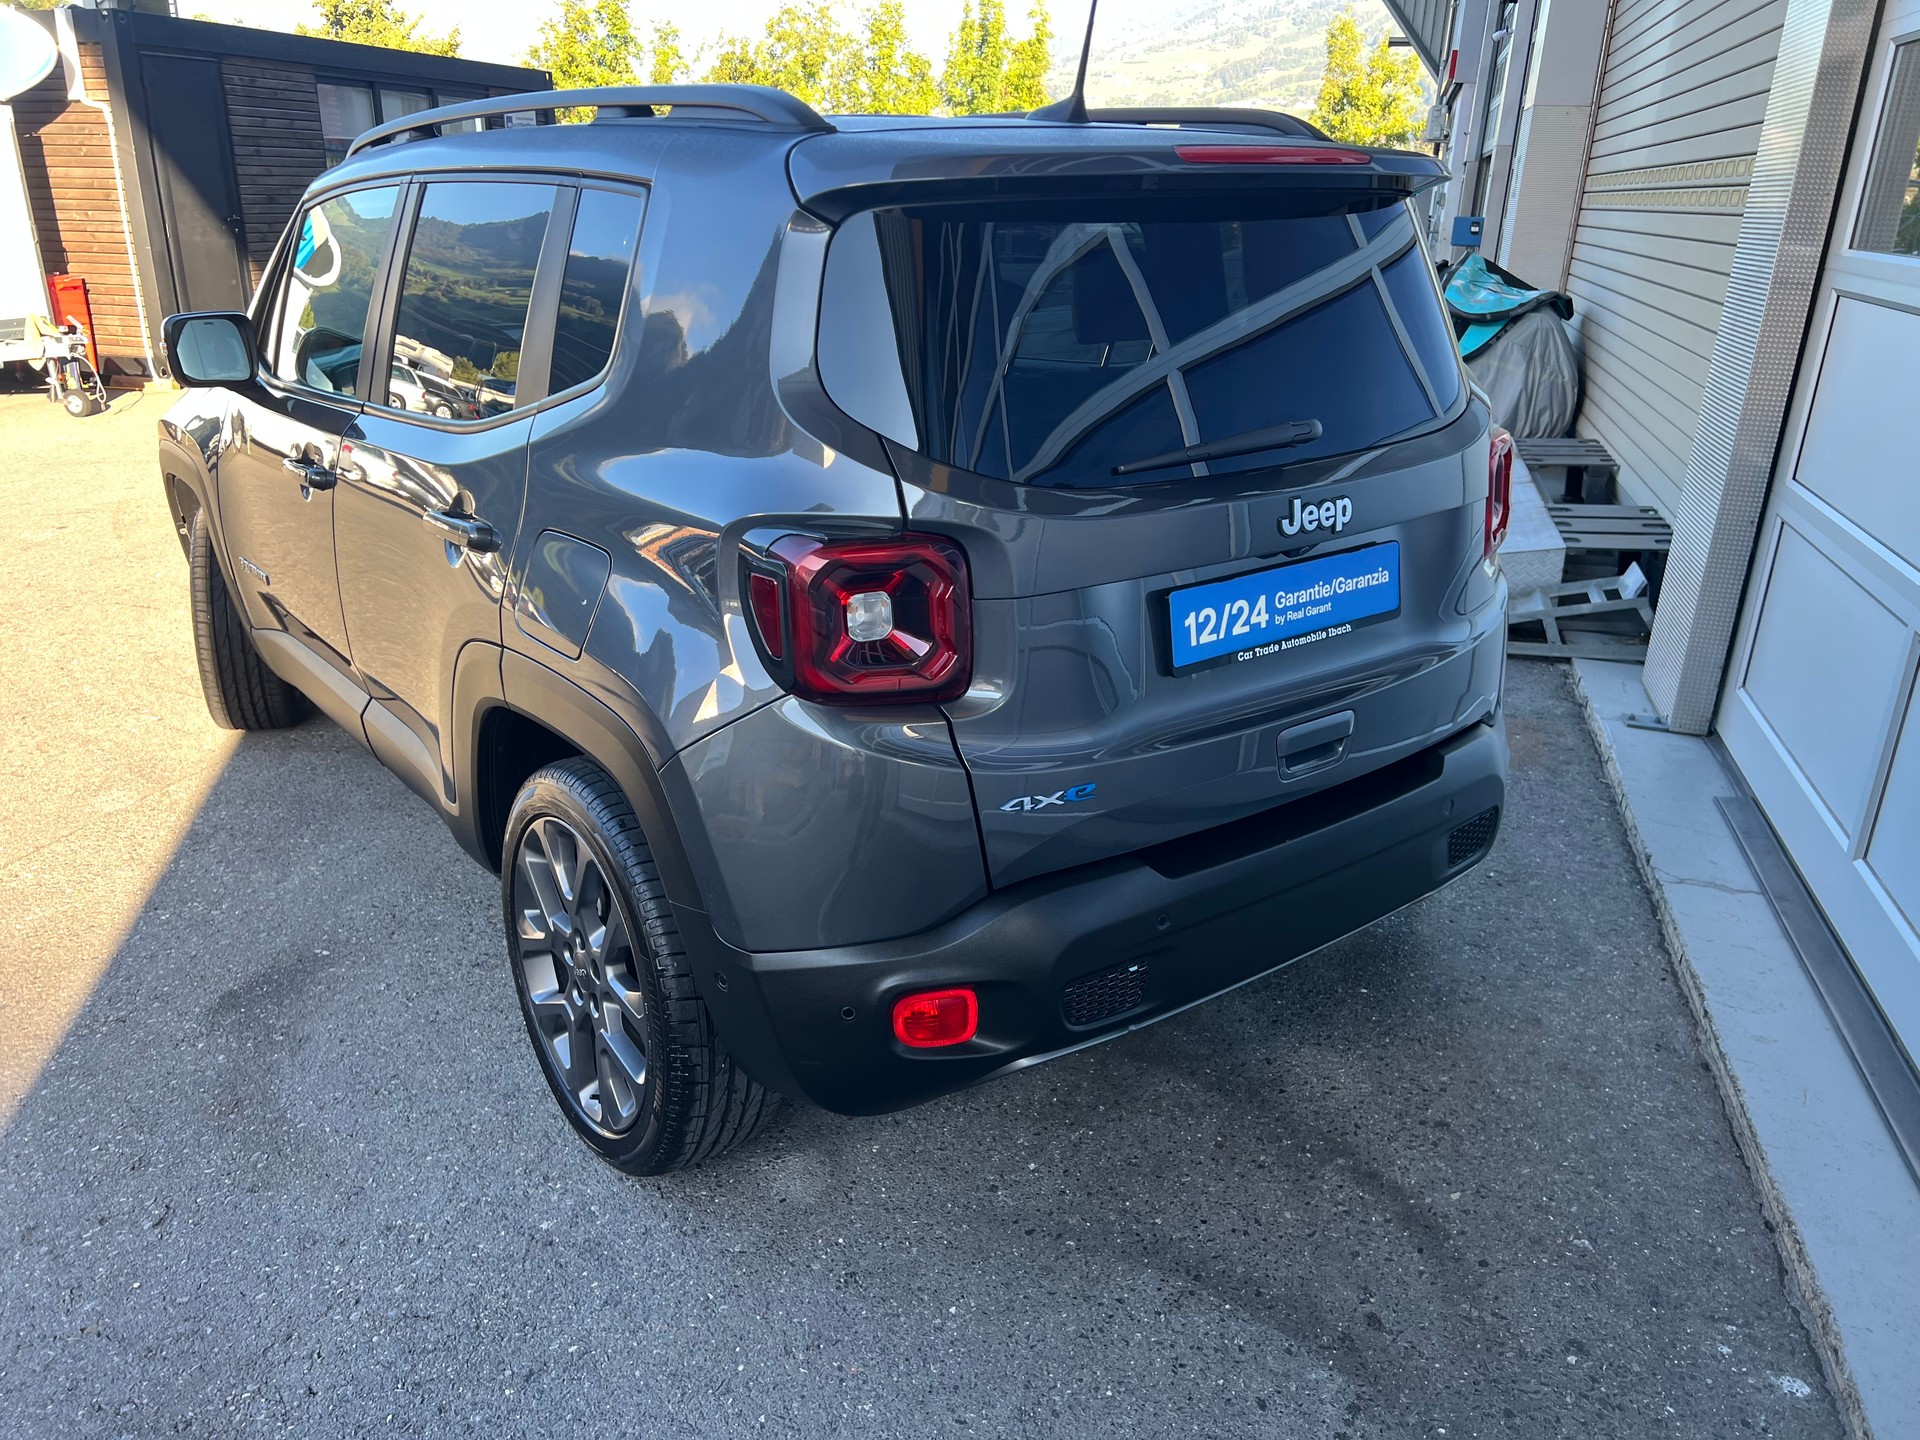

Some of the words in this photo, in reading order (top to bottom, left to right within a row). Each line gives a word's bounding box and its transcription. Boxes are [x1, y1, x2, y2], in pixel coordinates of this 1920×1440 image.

[1279, 494, 1353, 537] Jeep
[1275, 567, 1389, 608] Garantie/Garanzia
[1184, 595, 1269, 647] 12/24
[1275, 614, 1286, 626] by
[1287, 608, 1304, 622] Real
[1305, 602, 1332, 616] Garant
[1237, 651, 1253, 662] Car
[1255, 643, 1280, 657] Trade
[1281, 630, 1327, 650] Automobile
[1328, 623, 1352, 637] Ibach
